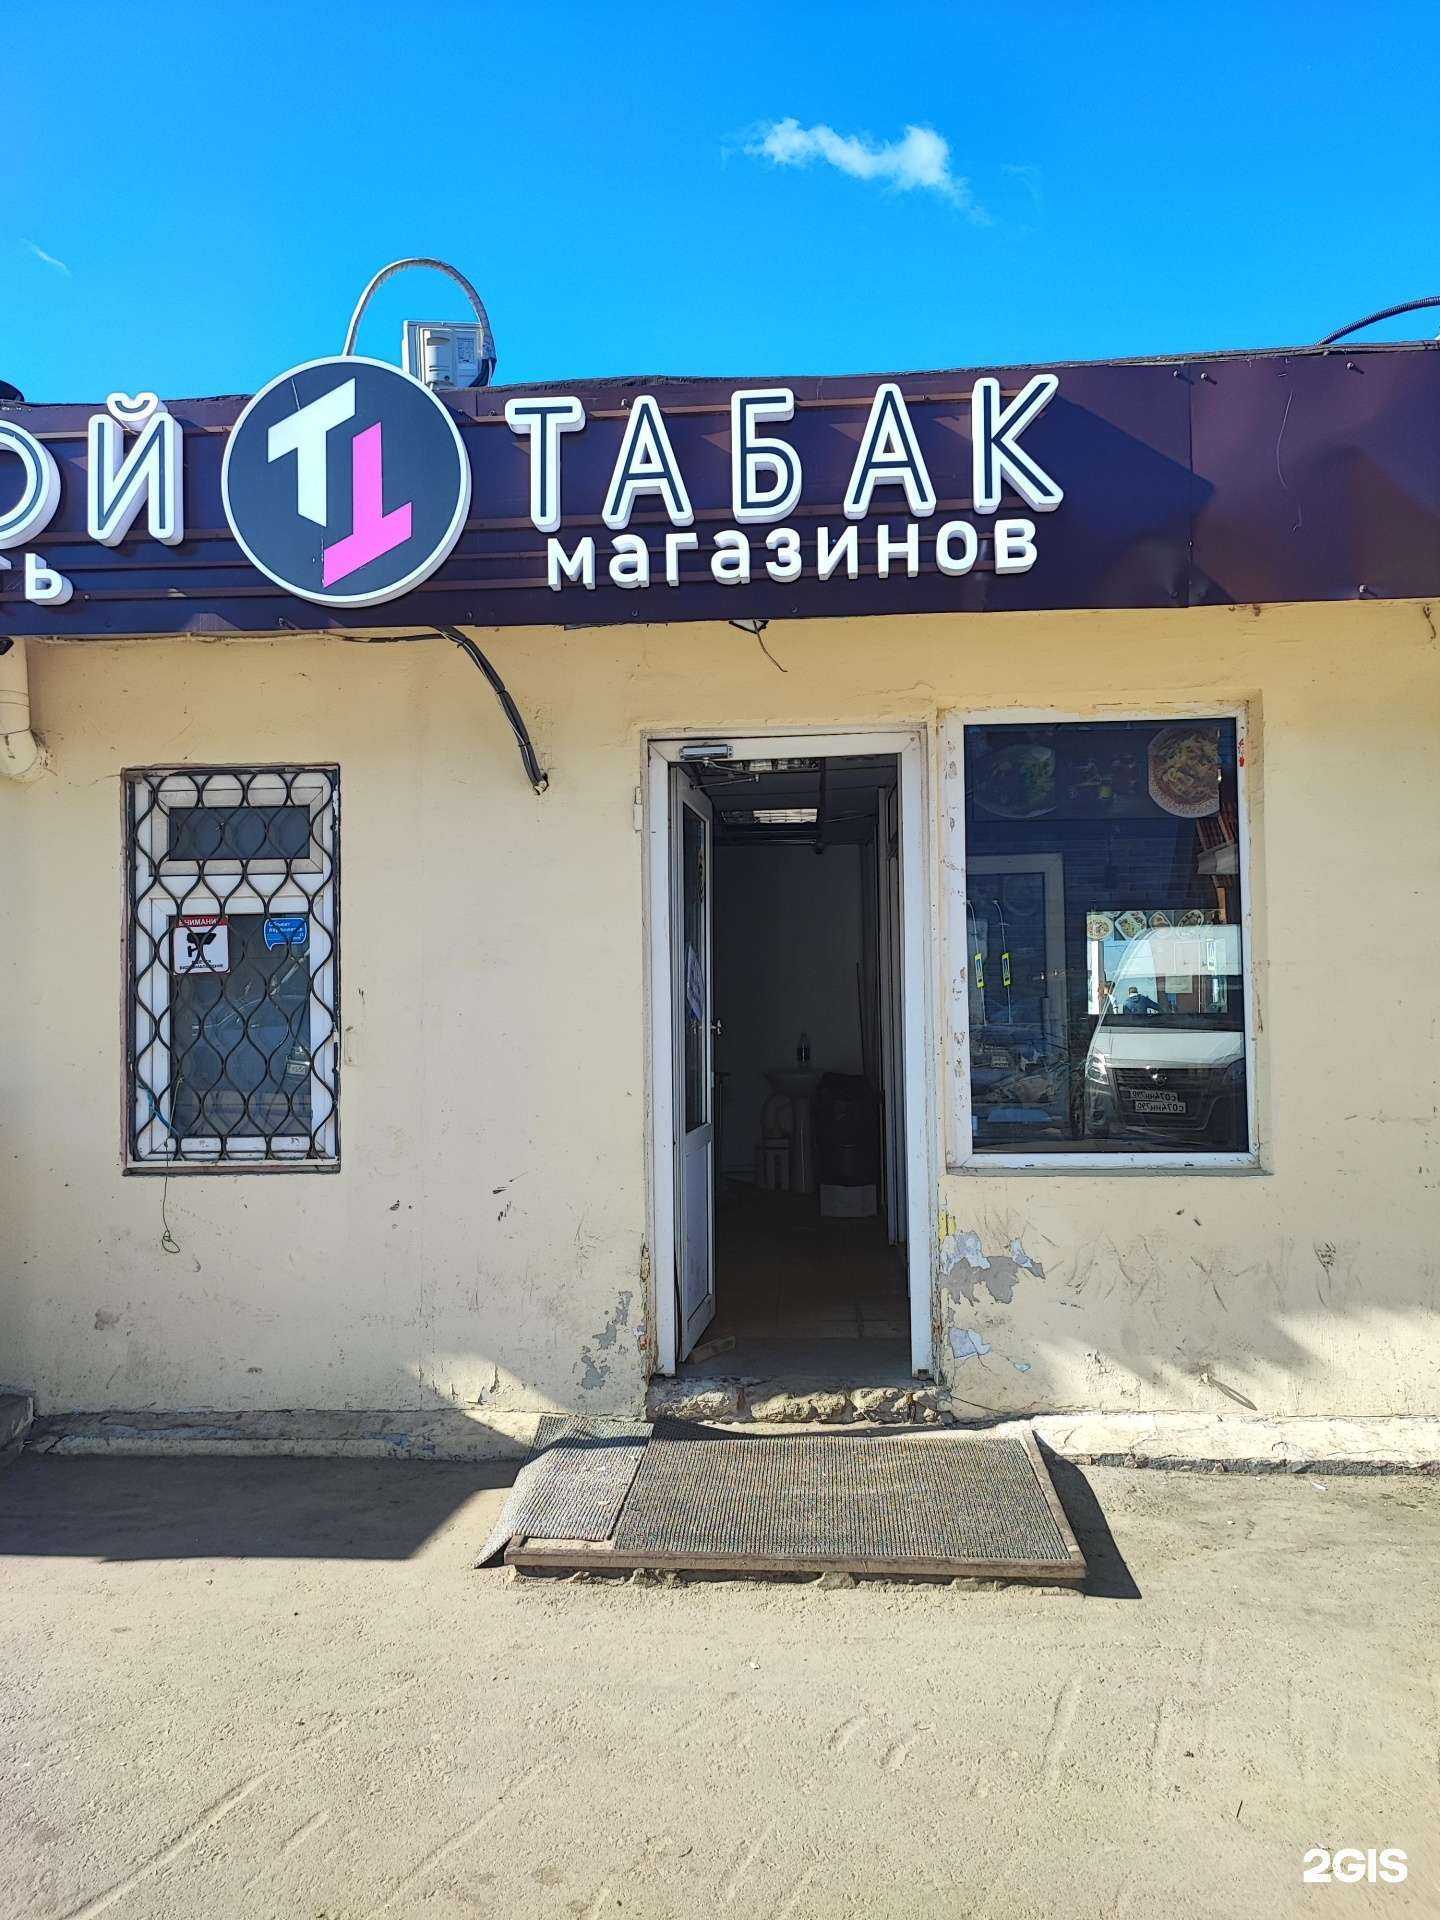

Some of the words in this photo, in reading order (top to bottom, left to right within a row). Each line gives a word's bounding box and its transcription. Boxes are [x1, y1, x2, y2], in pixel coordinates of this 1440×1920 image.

[505, 374, 1064, 533] ТАБАК
[0, 552, 74, 606] ь
[546, 517, 1039, 592] магазинов
